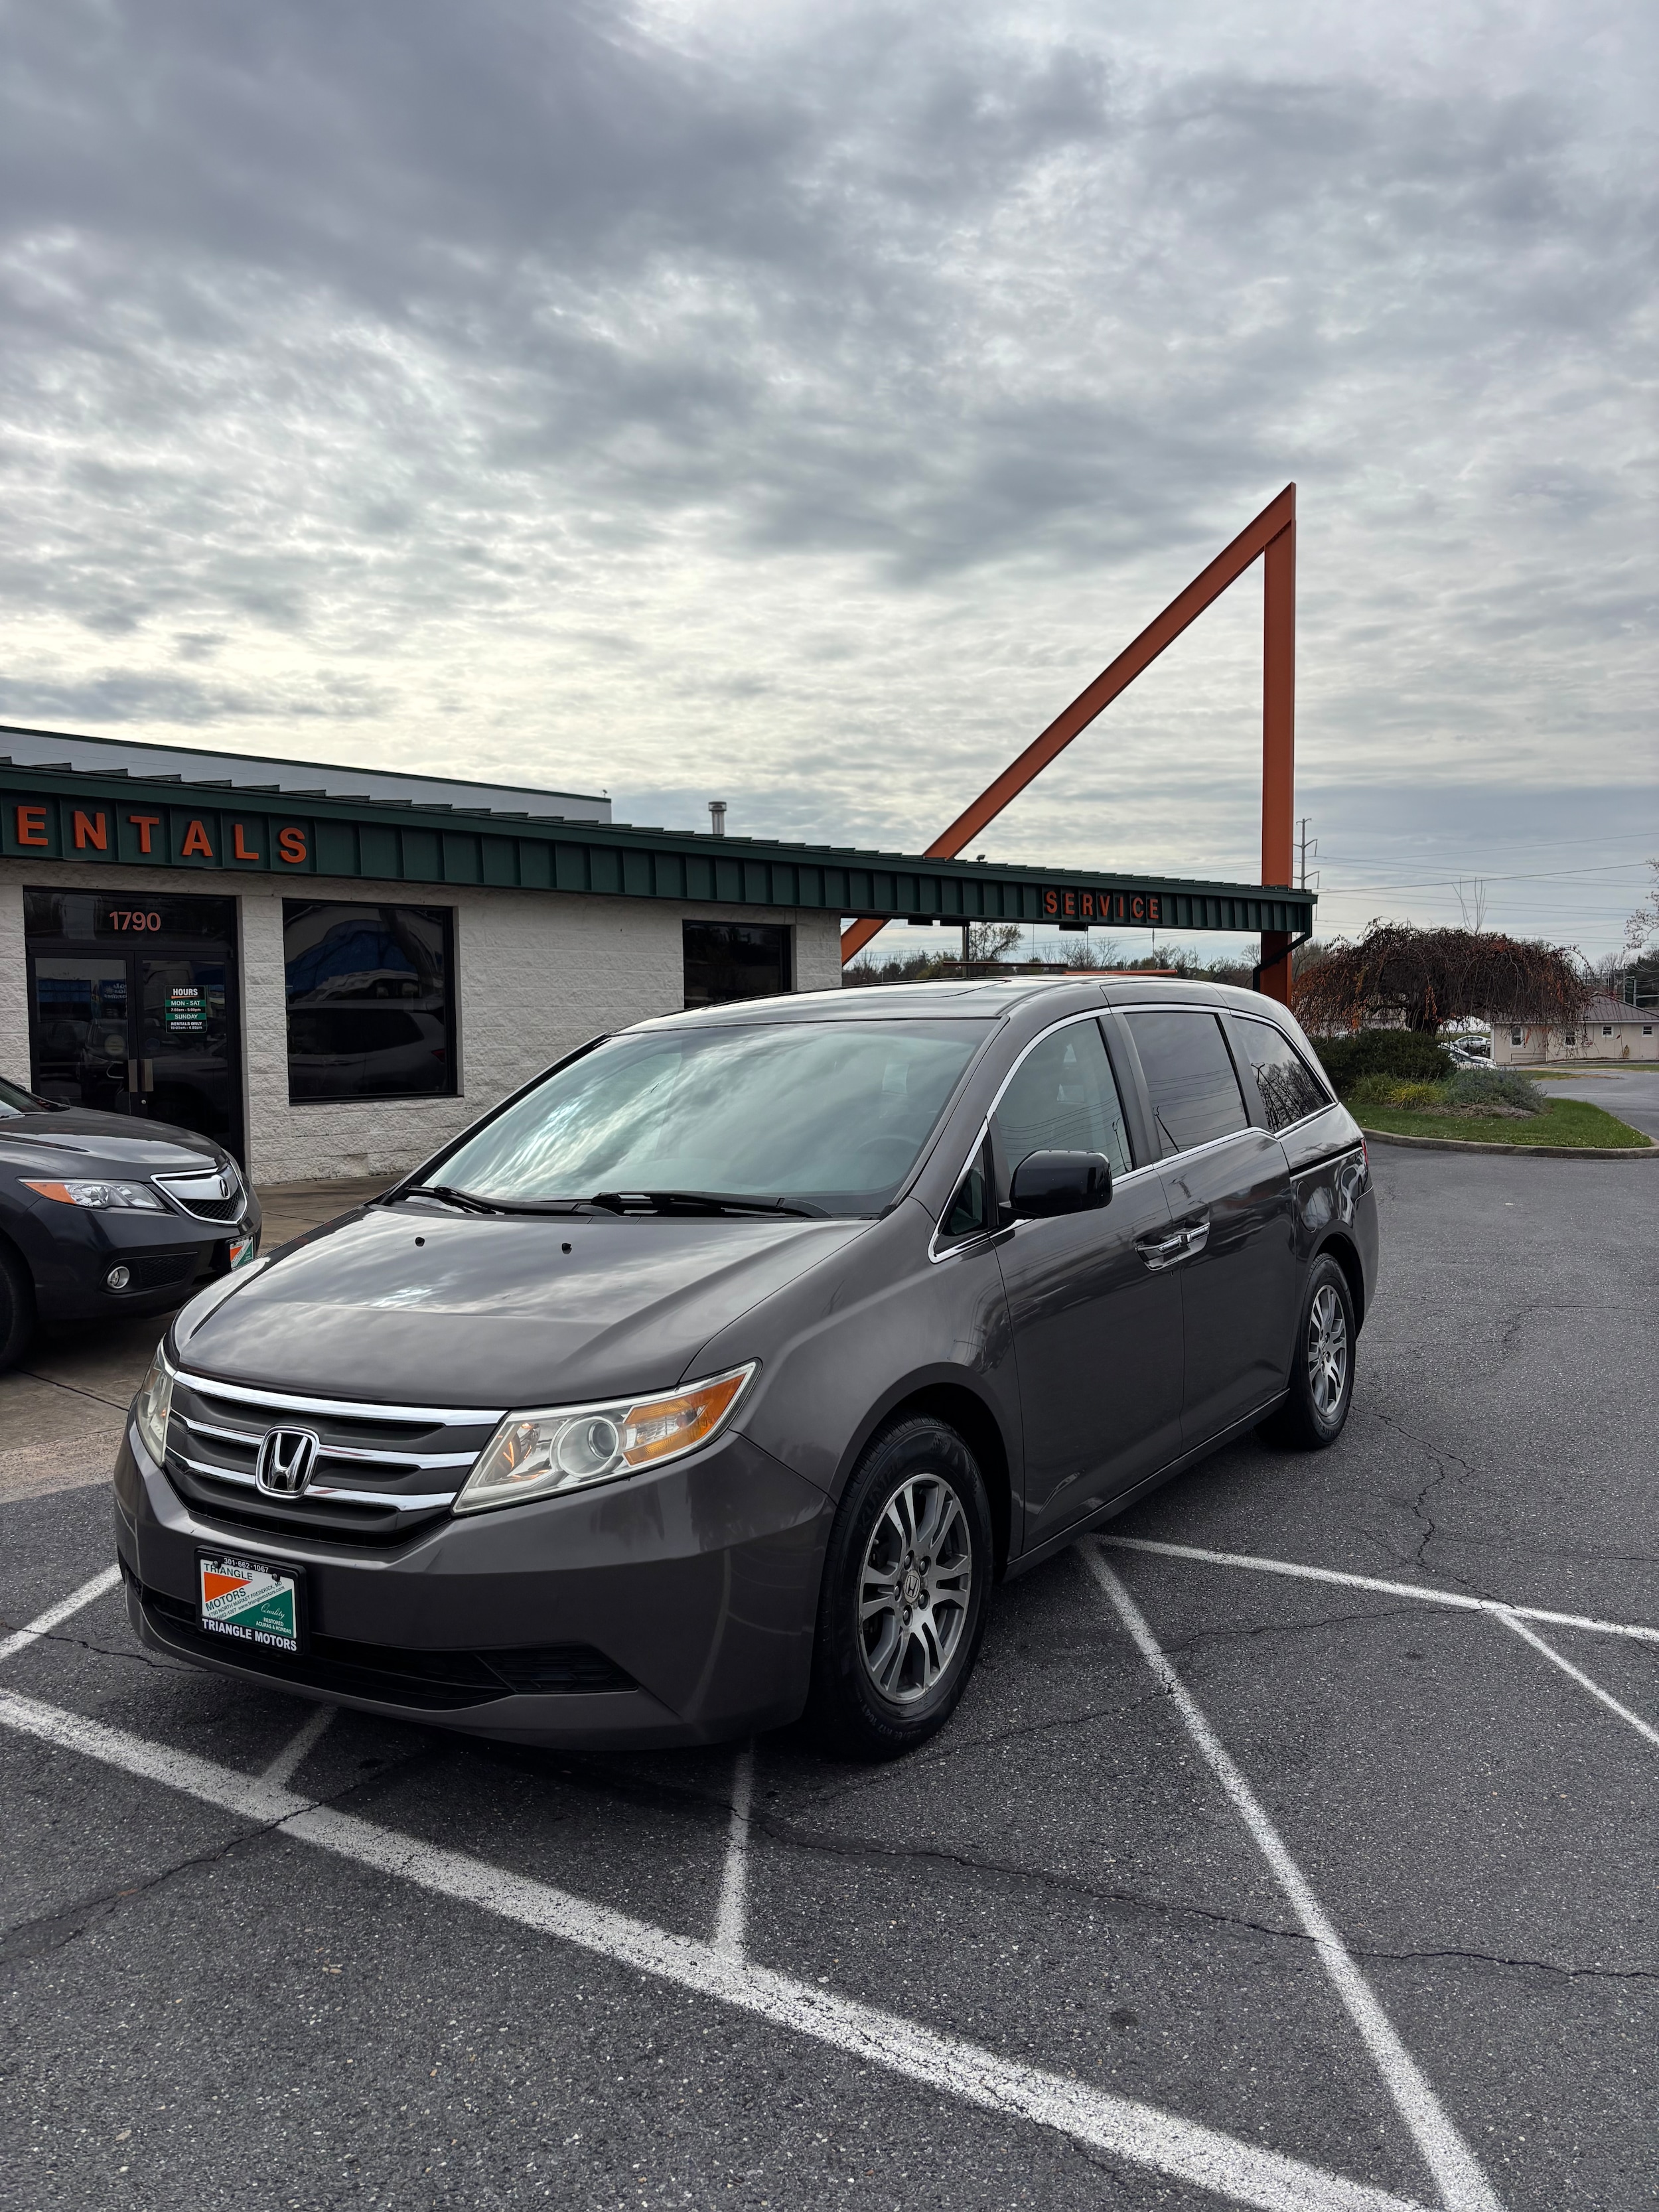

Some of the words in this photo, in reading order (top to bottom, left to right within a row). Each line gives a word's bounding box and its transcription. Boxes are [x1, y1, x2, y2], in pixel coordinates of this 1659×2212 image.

[17, 806, 307, 863] ENTALS
[1045, 890, 1159, 919] SERVICE
[109, 911, 161, 932] 1790
[205, 1587, 246, 1611] MOTORS
[218, 1603, 234, 1613] NORTH
[233, 1595, 250, 1607] MARKET
[261, 1603, 285, 1620] Quality
[263, 1617, 284, 1627] RESTORED
[202, 1618, 252, 1640] TRIANGLE
[255, 1631, 297, 1651] MOTORS
[275, 1625, 292, 1635] HONDAS
